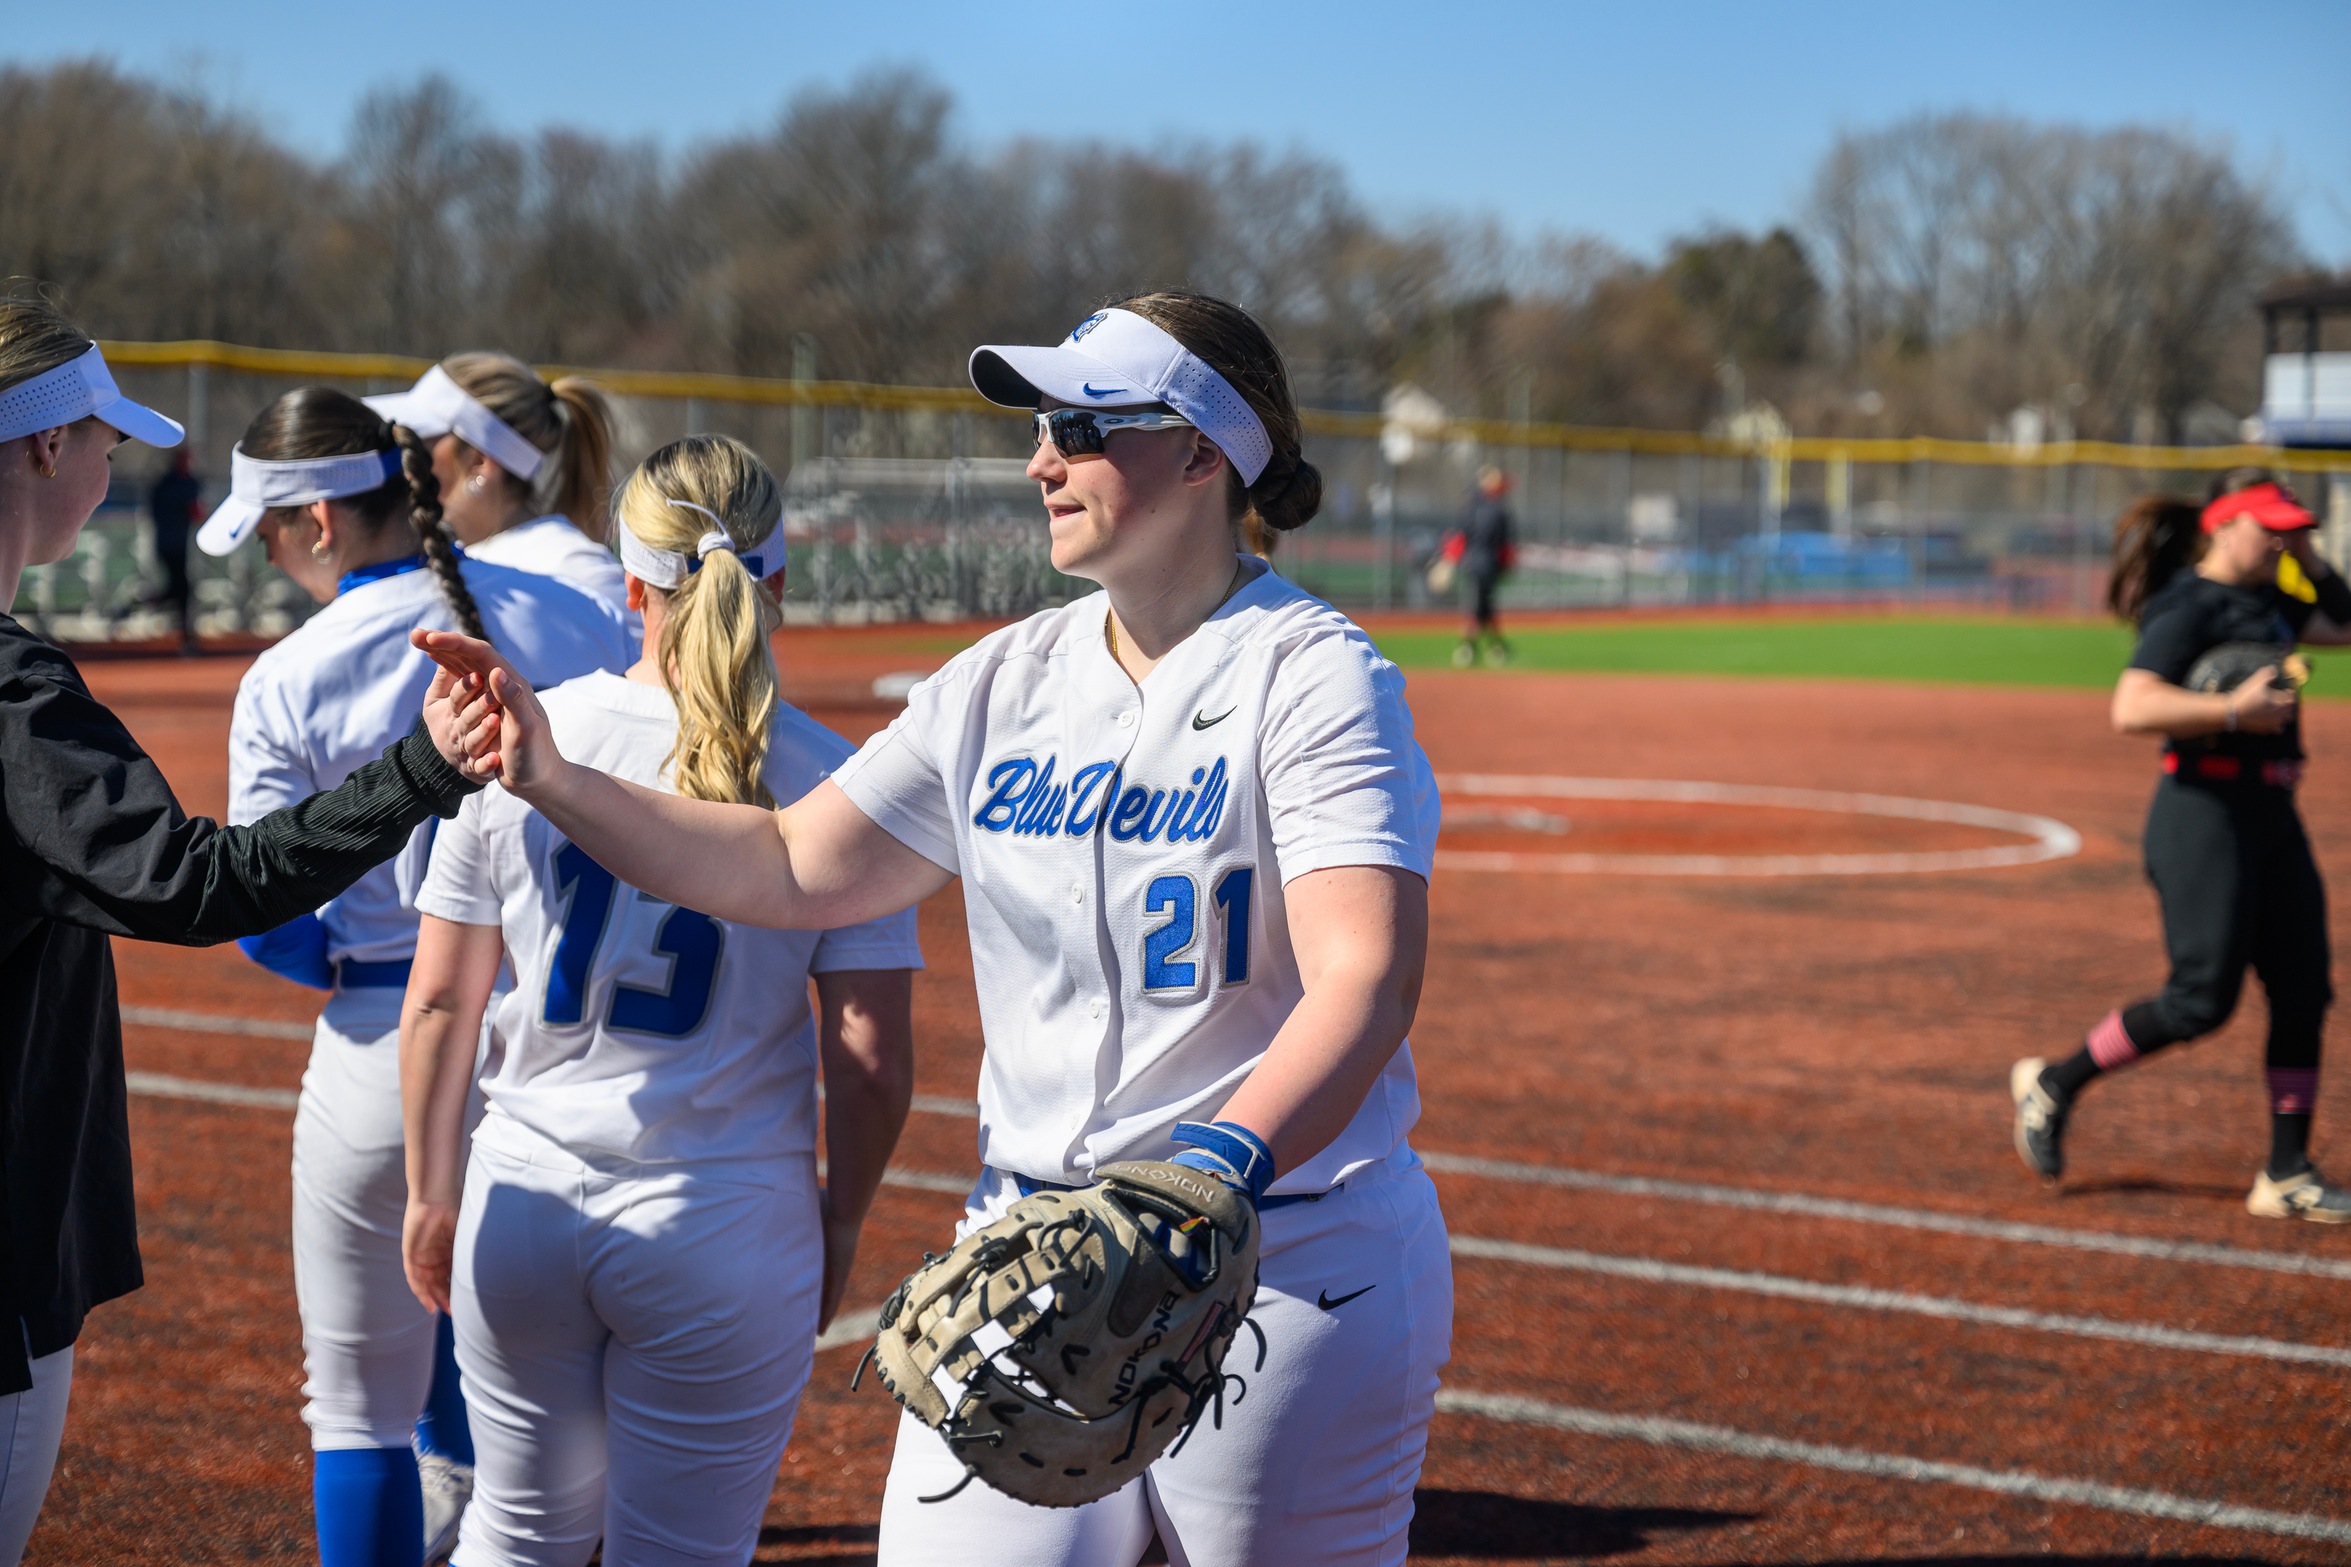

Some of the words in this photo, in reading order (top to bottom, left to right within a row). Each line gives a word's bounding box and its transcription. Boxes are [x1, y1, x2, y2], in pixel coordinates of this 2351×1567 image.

[973, 754, 1069, 838] Blue
[1064, 753, 1229, 846] Devils
[538, 839, 725, 1041] 13
[1140, 863, 1256, 994] 21
